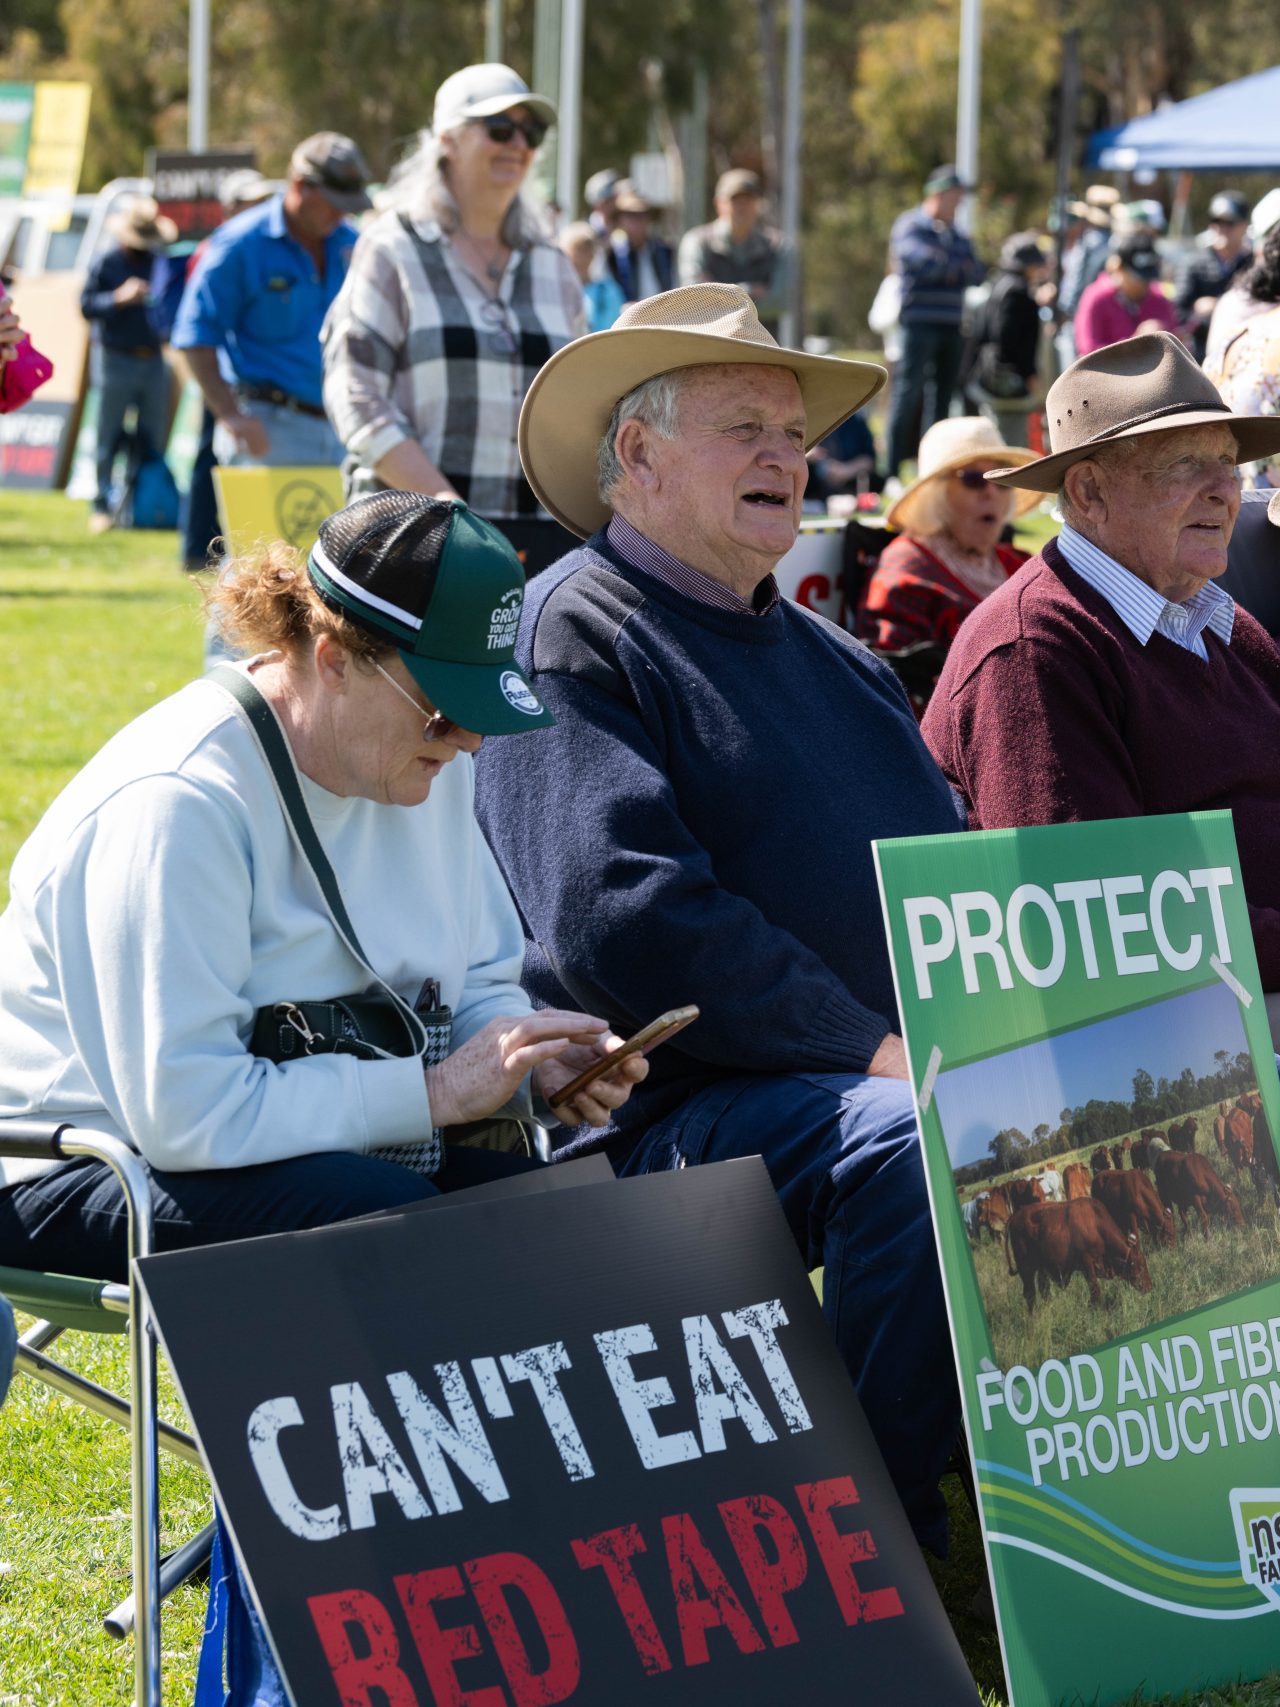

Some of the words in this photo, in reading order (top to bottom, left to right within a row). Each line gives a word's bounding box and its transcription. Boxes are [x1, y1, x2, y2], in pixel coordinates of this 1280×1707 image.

[490, 624, 504, 634] YOU
[902, 866, 1234, 1000] PROTECT
[246, 1341, 596, 1541] CAN'T
[593, 1298, 813, 1470] EAT
[975, 1353, 1104, 1431] FOOD
[1116, 1335, 1204, 1405] AND
[307, 1551, 581, 1707] RED
[570, 1475, 905, 1676] TAPE
